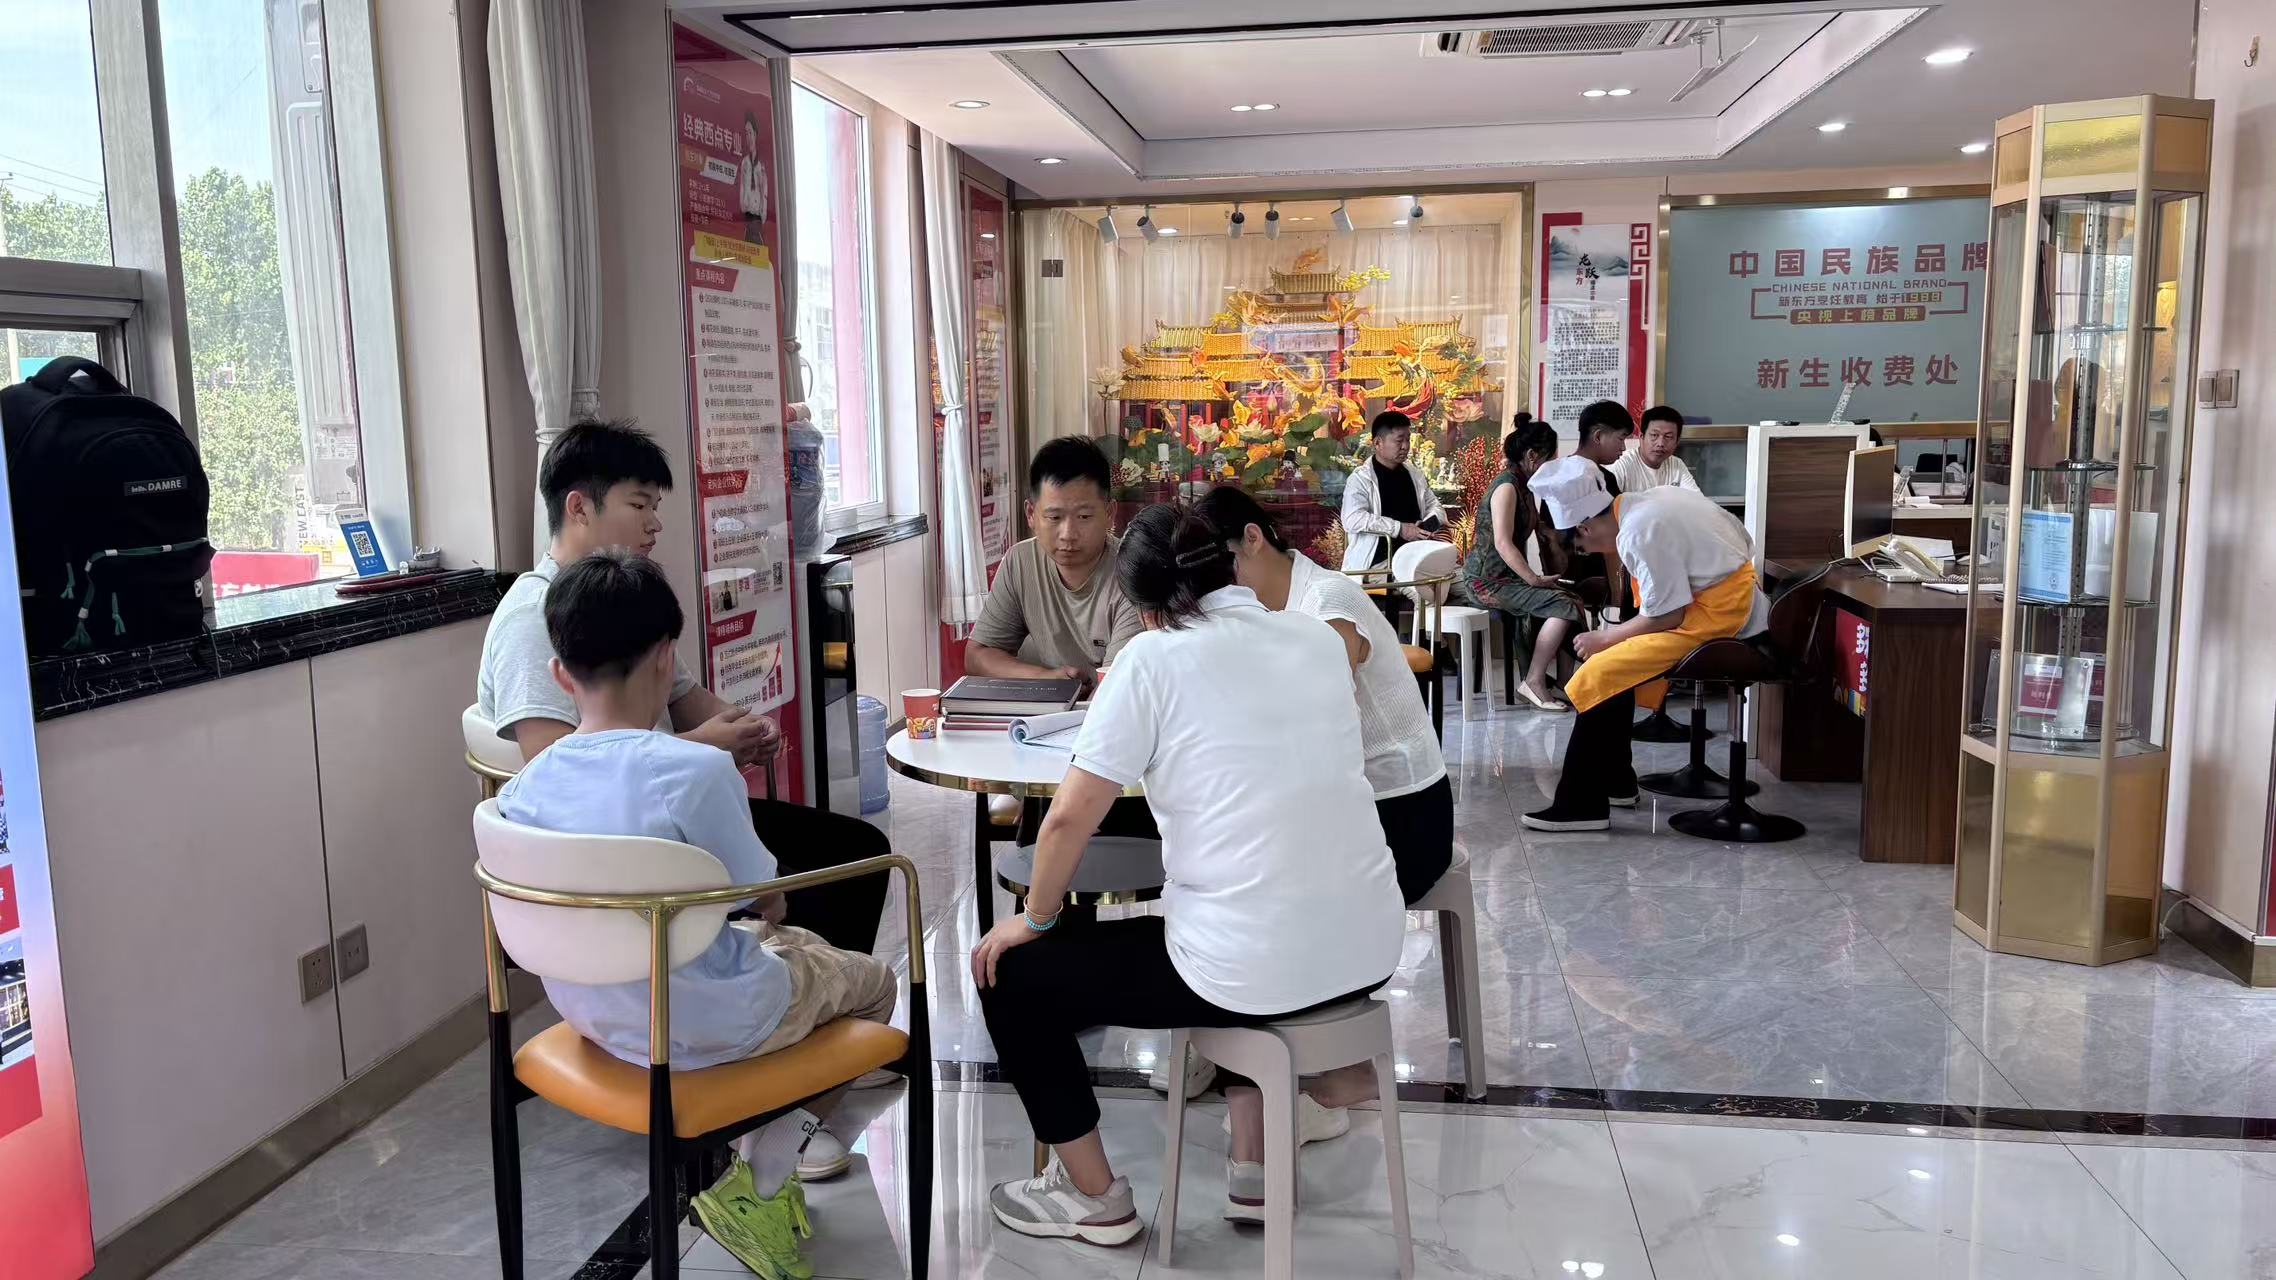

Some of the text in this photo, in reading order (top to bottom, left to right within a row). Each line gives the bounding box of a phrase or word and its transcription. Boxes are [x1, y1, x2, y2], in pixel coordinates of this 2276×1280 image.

[683, 111, 743, 157] 经典西点专业
[1729, 242, 1988, 278] 中国民族品牌
[1772, 278, 1947, 293] CHINESE NATIONAL BRAND
[1778, 293, 1868, 307] 新东方烹饪教育
[1797, 307, 1918, 323] 央视上榜品牌
[1757, 354, 1958, 389] 新生收费处
